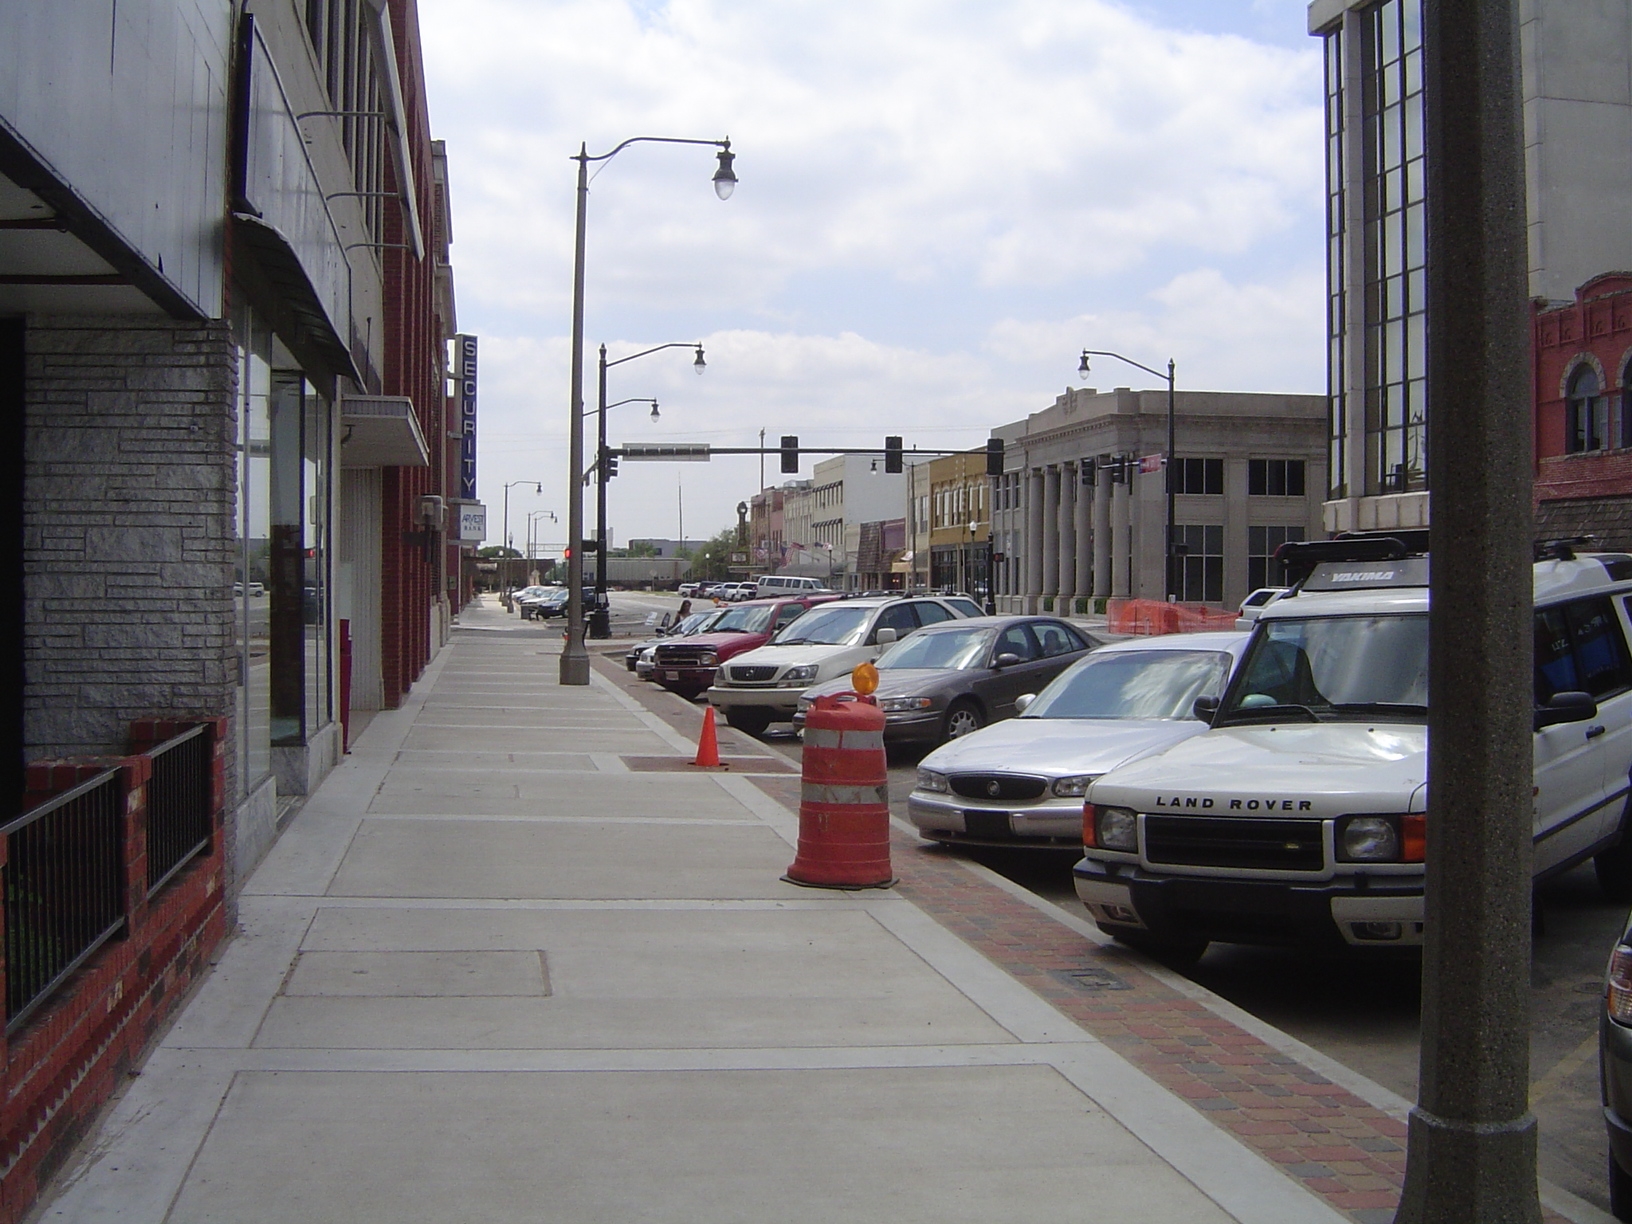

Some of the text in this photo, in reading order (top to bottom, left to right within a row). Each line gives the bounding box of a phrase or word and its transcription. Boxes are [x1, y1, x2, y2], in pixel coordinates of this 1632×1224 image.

[463, 341, 476, 491] SECURITY
[1332, 571, 1394, 582] YAKIMA
[1156, 796, 1312, 811] LAND ROVER
